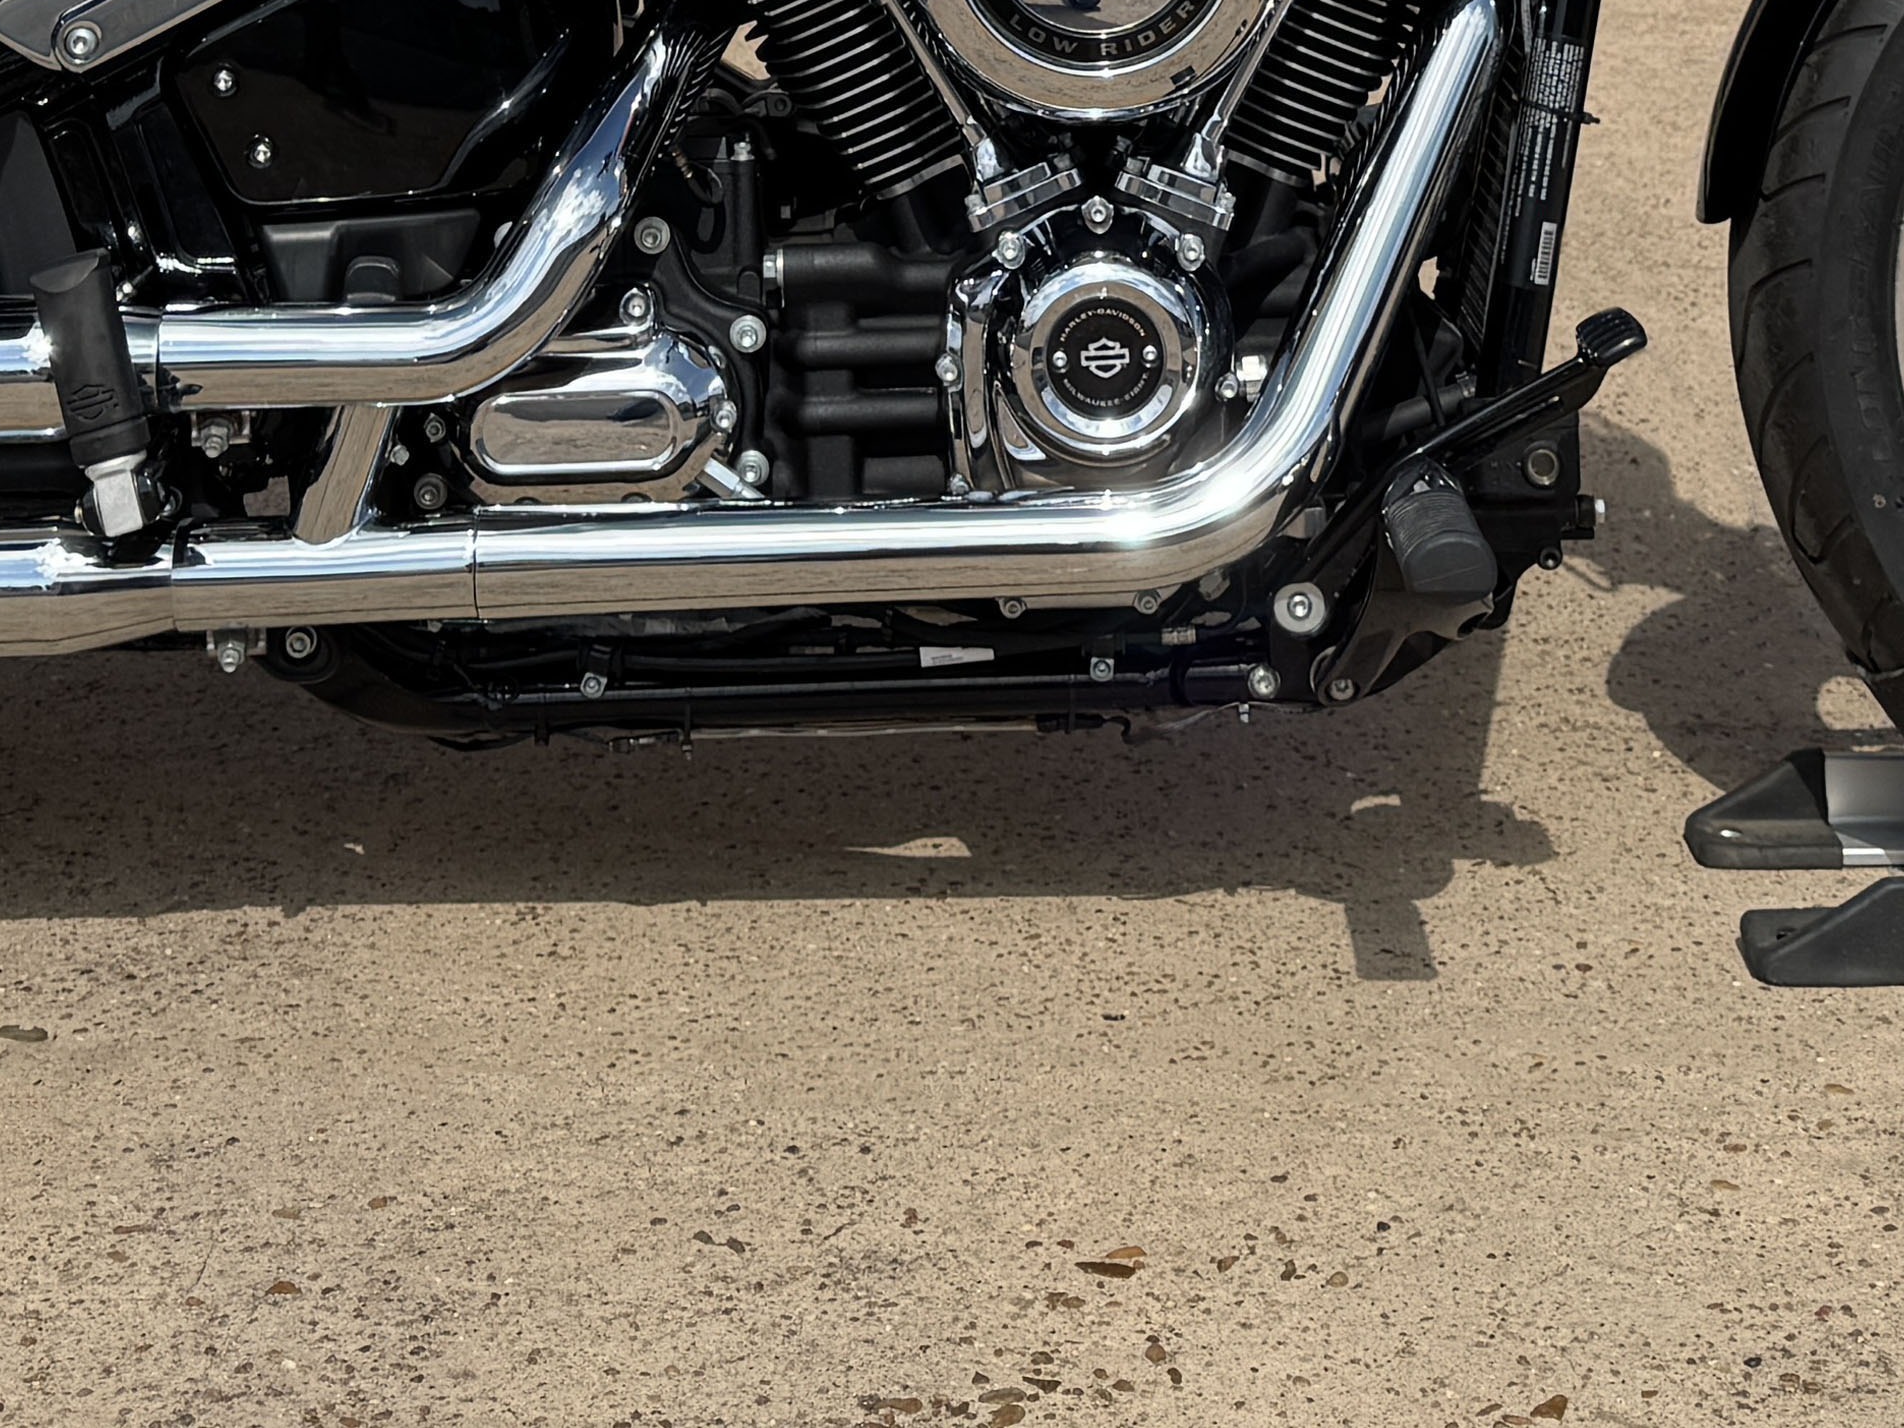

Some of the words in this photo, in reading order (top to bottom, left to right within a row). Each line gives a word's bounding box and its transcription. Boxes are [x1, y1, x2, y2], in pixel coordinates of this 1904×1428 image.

[1007, 13, 1079, 54] LOW
[1099, 0, 1198, 57] RIDER
[1059, 307, 1147, 342] HARLEY-DAVIDSON
